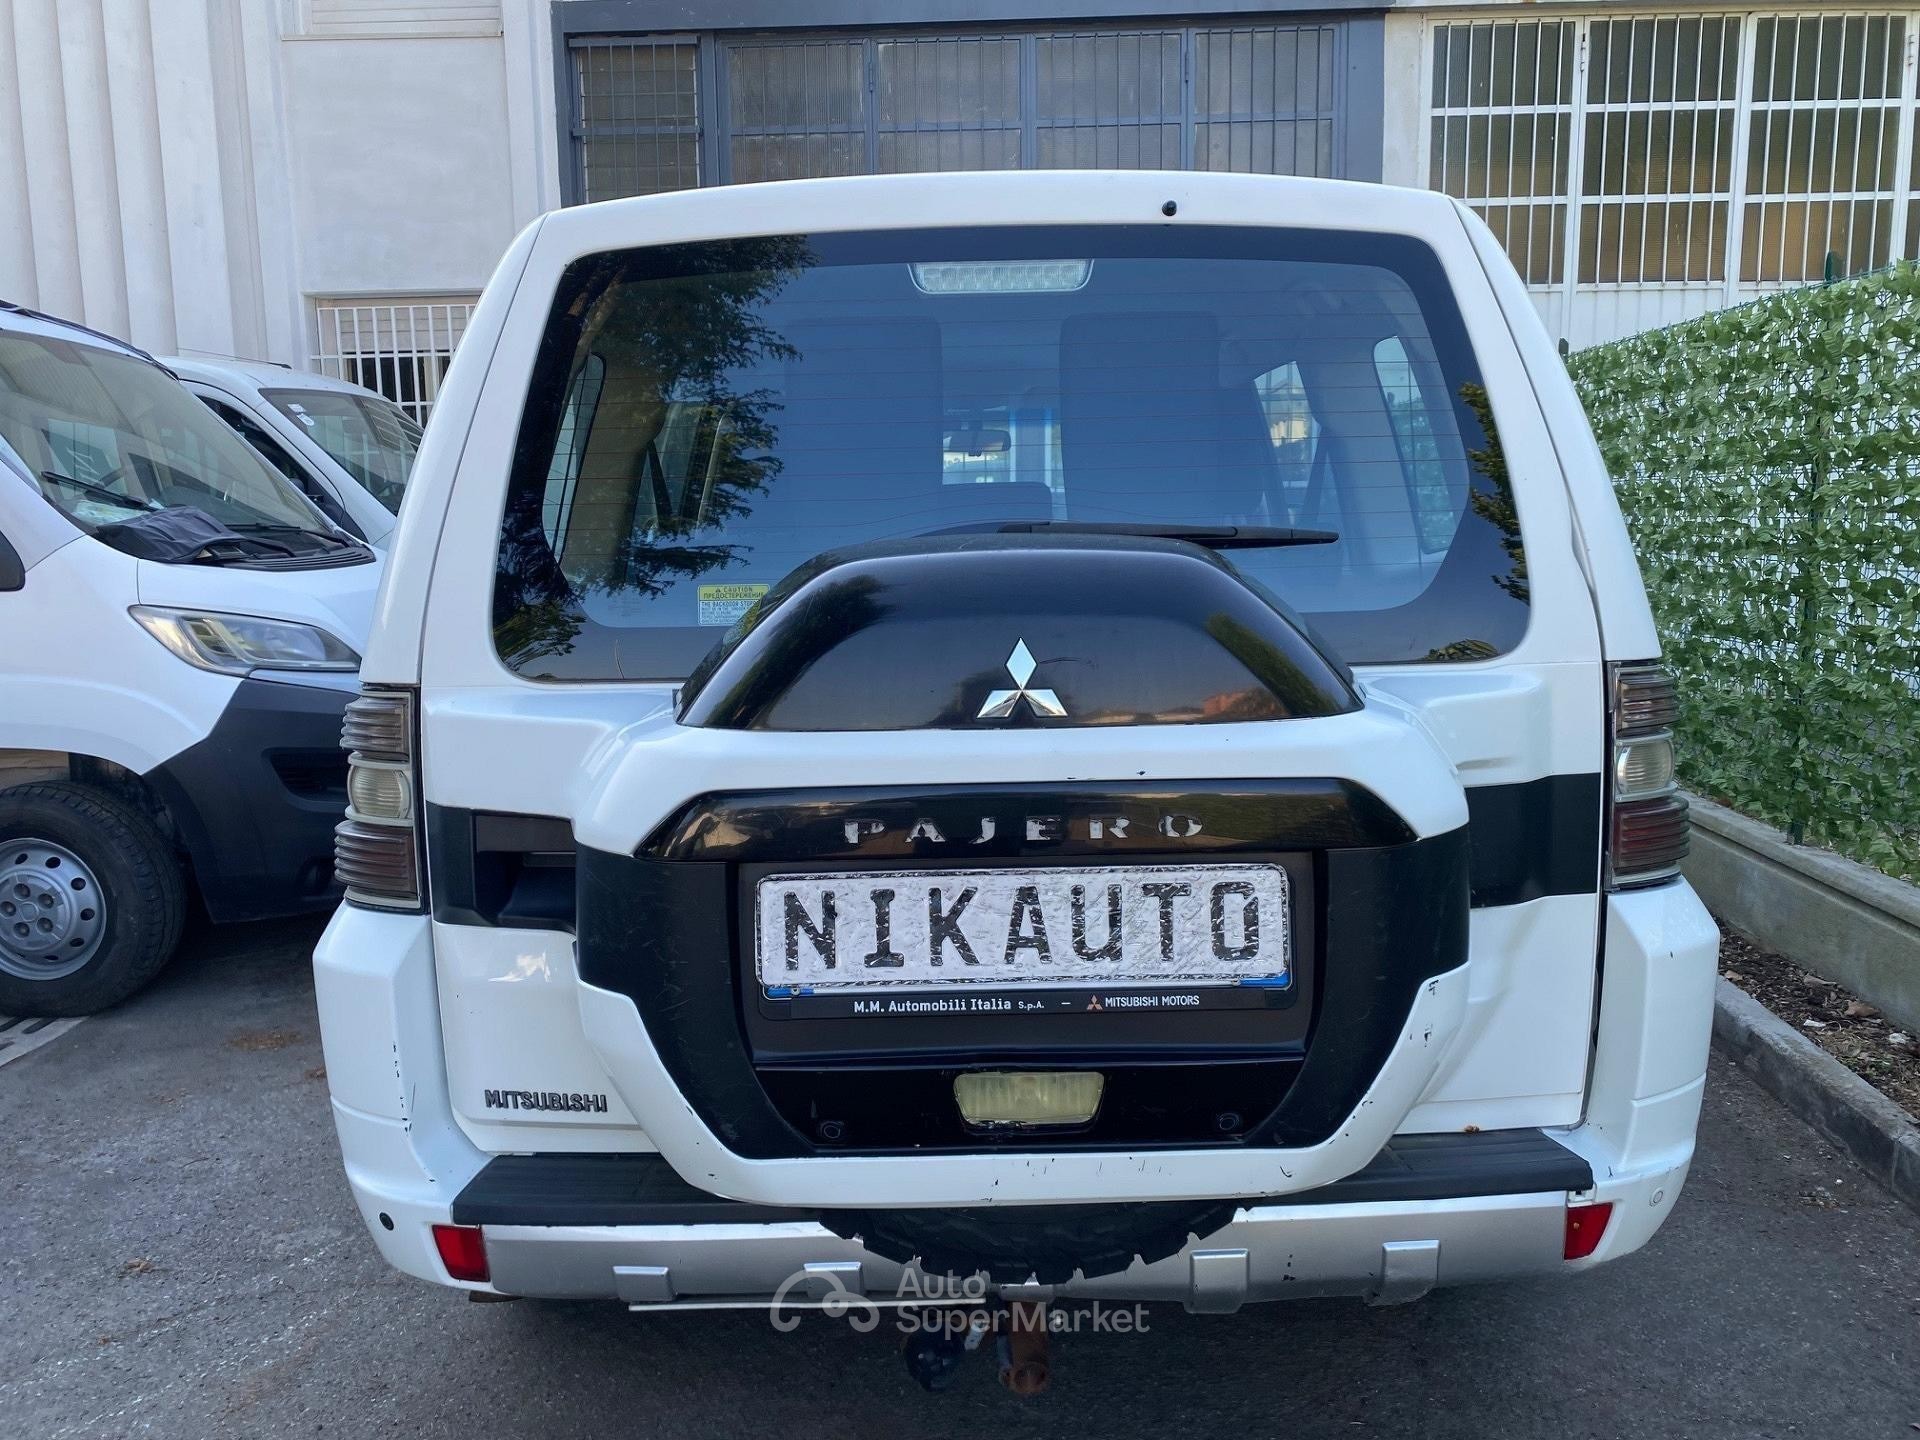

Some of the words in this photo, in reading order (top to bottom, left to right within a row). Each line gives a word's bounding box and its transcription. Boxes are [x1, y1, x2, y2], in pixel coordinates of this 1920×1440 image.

[844, 814, 1203, 845] PAJERO
[784, 881, 1260, 971] NIKAUTO
[853, 1000, 885, 1013] M.M.
[888, 999, 967, 1012] Automobili
[970, 998, 1012, 1011] Italia
[1105, 996, 1159, 1008] MITSUBISHI
[1162, 995, 1201, 1006] MOTORS
[484, 1089, 608, 1113] MITSUBISHI
